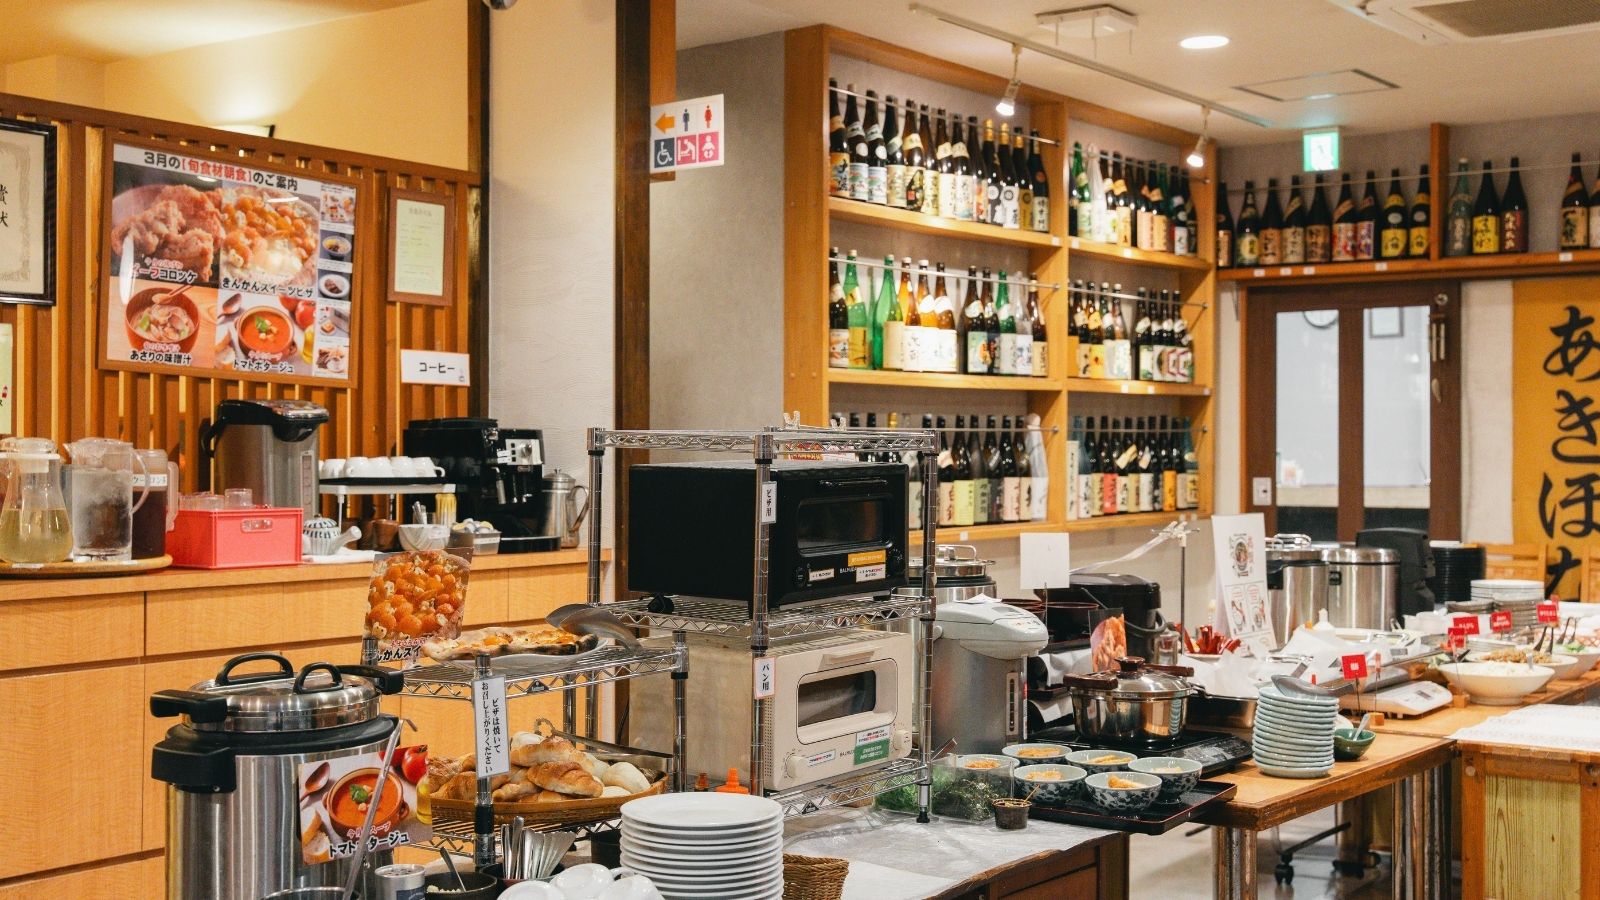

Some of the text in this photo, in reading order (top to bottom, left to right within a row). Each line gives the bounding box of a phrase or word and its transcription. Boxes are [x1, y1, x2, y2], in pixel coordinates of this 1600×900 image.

[419, 362, 455, 373] コーヒー
[762, 663, 770, 691] パン用
[482, 682, 493, 774] お召し上がりください
[492, 698, 501, 753] ピザは焼いて
[329, 831, 409, 858] トマトタージュ
